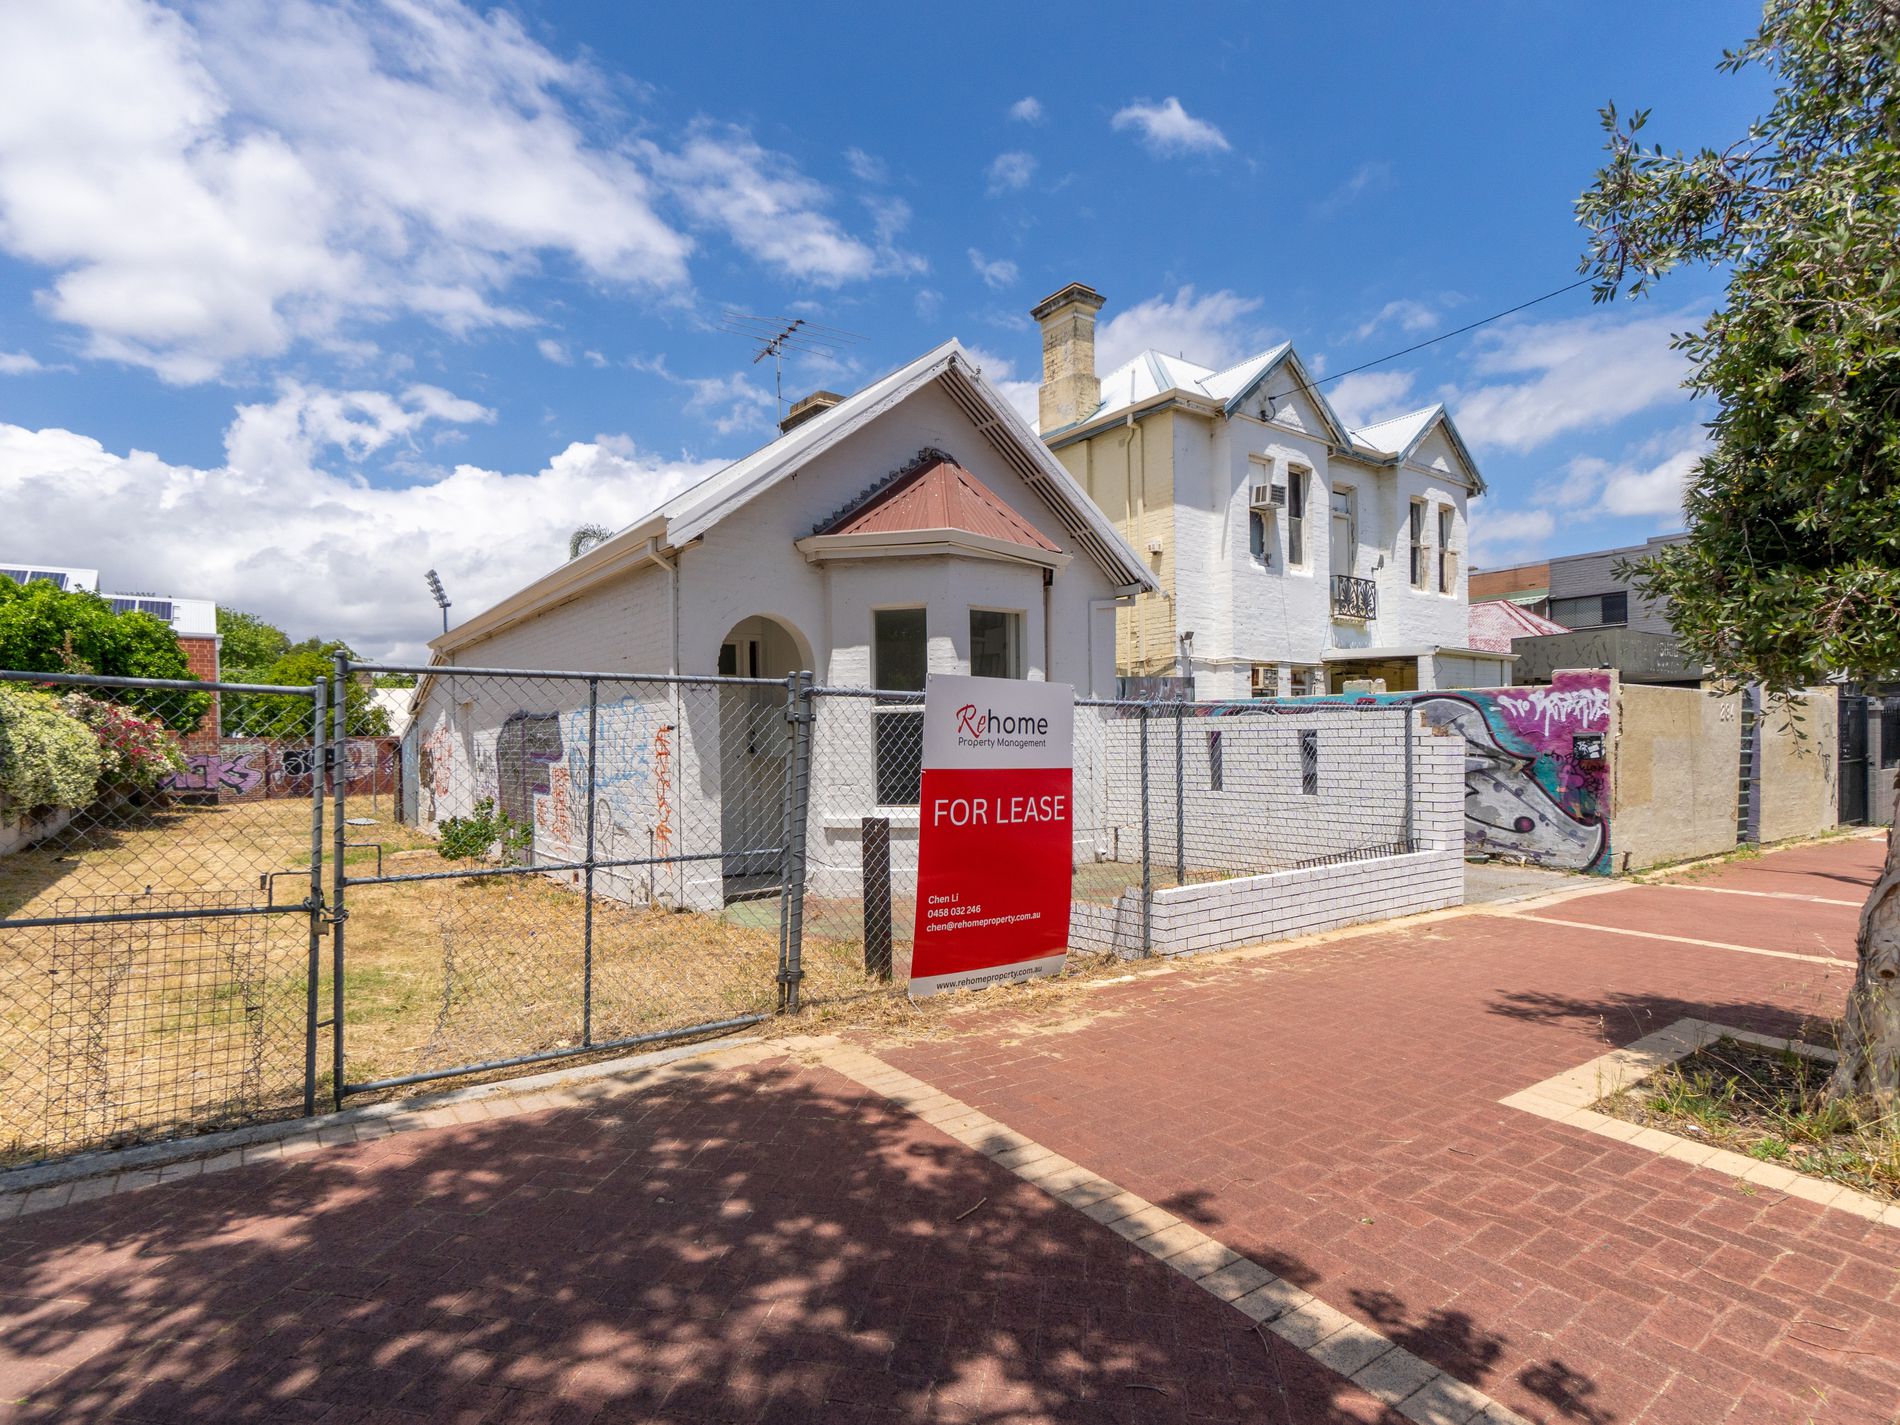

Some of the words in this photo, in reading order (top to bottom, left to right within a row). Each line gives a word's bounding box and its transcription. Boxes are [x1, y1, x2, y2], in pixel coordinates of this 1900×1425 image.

[956, 704, 1048, 738] Rehome
[958, 737, 995, 749] Property
[997, 738, 1046, 749] Management
[934, 798, 988, 827] FOR
[996, 796, 1065, 824] LEASE
[928, 895, 950, 905] Chen
[951, 893, 959, 902] Li
[926, 911, 1041, 932] chen@rehomeproperty.com.au
[927, 908, 949, 918] 0458
[950, 906, 965, 916] 032
[966, 904, 981, 914] 246
[936, 966, 1043, 990] www.rehomeproperty.com.au
